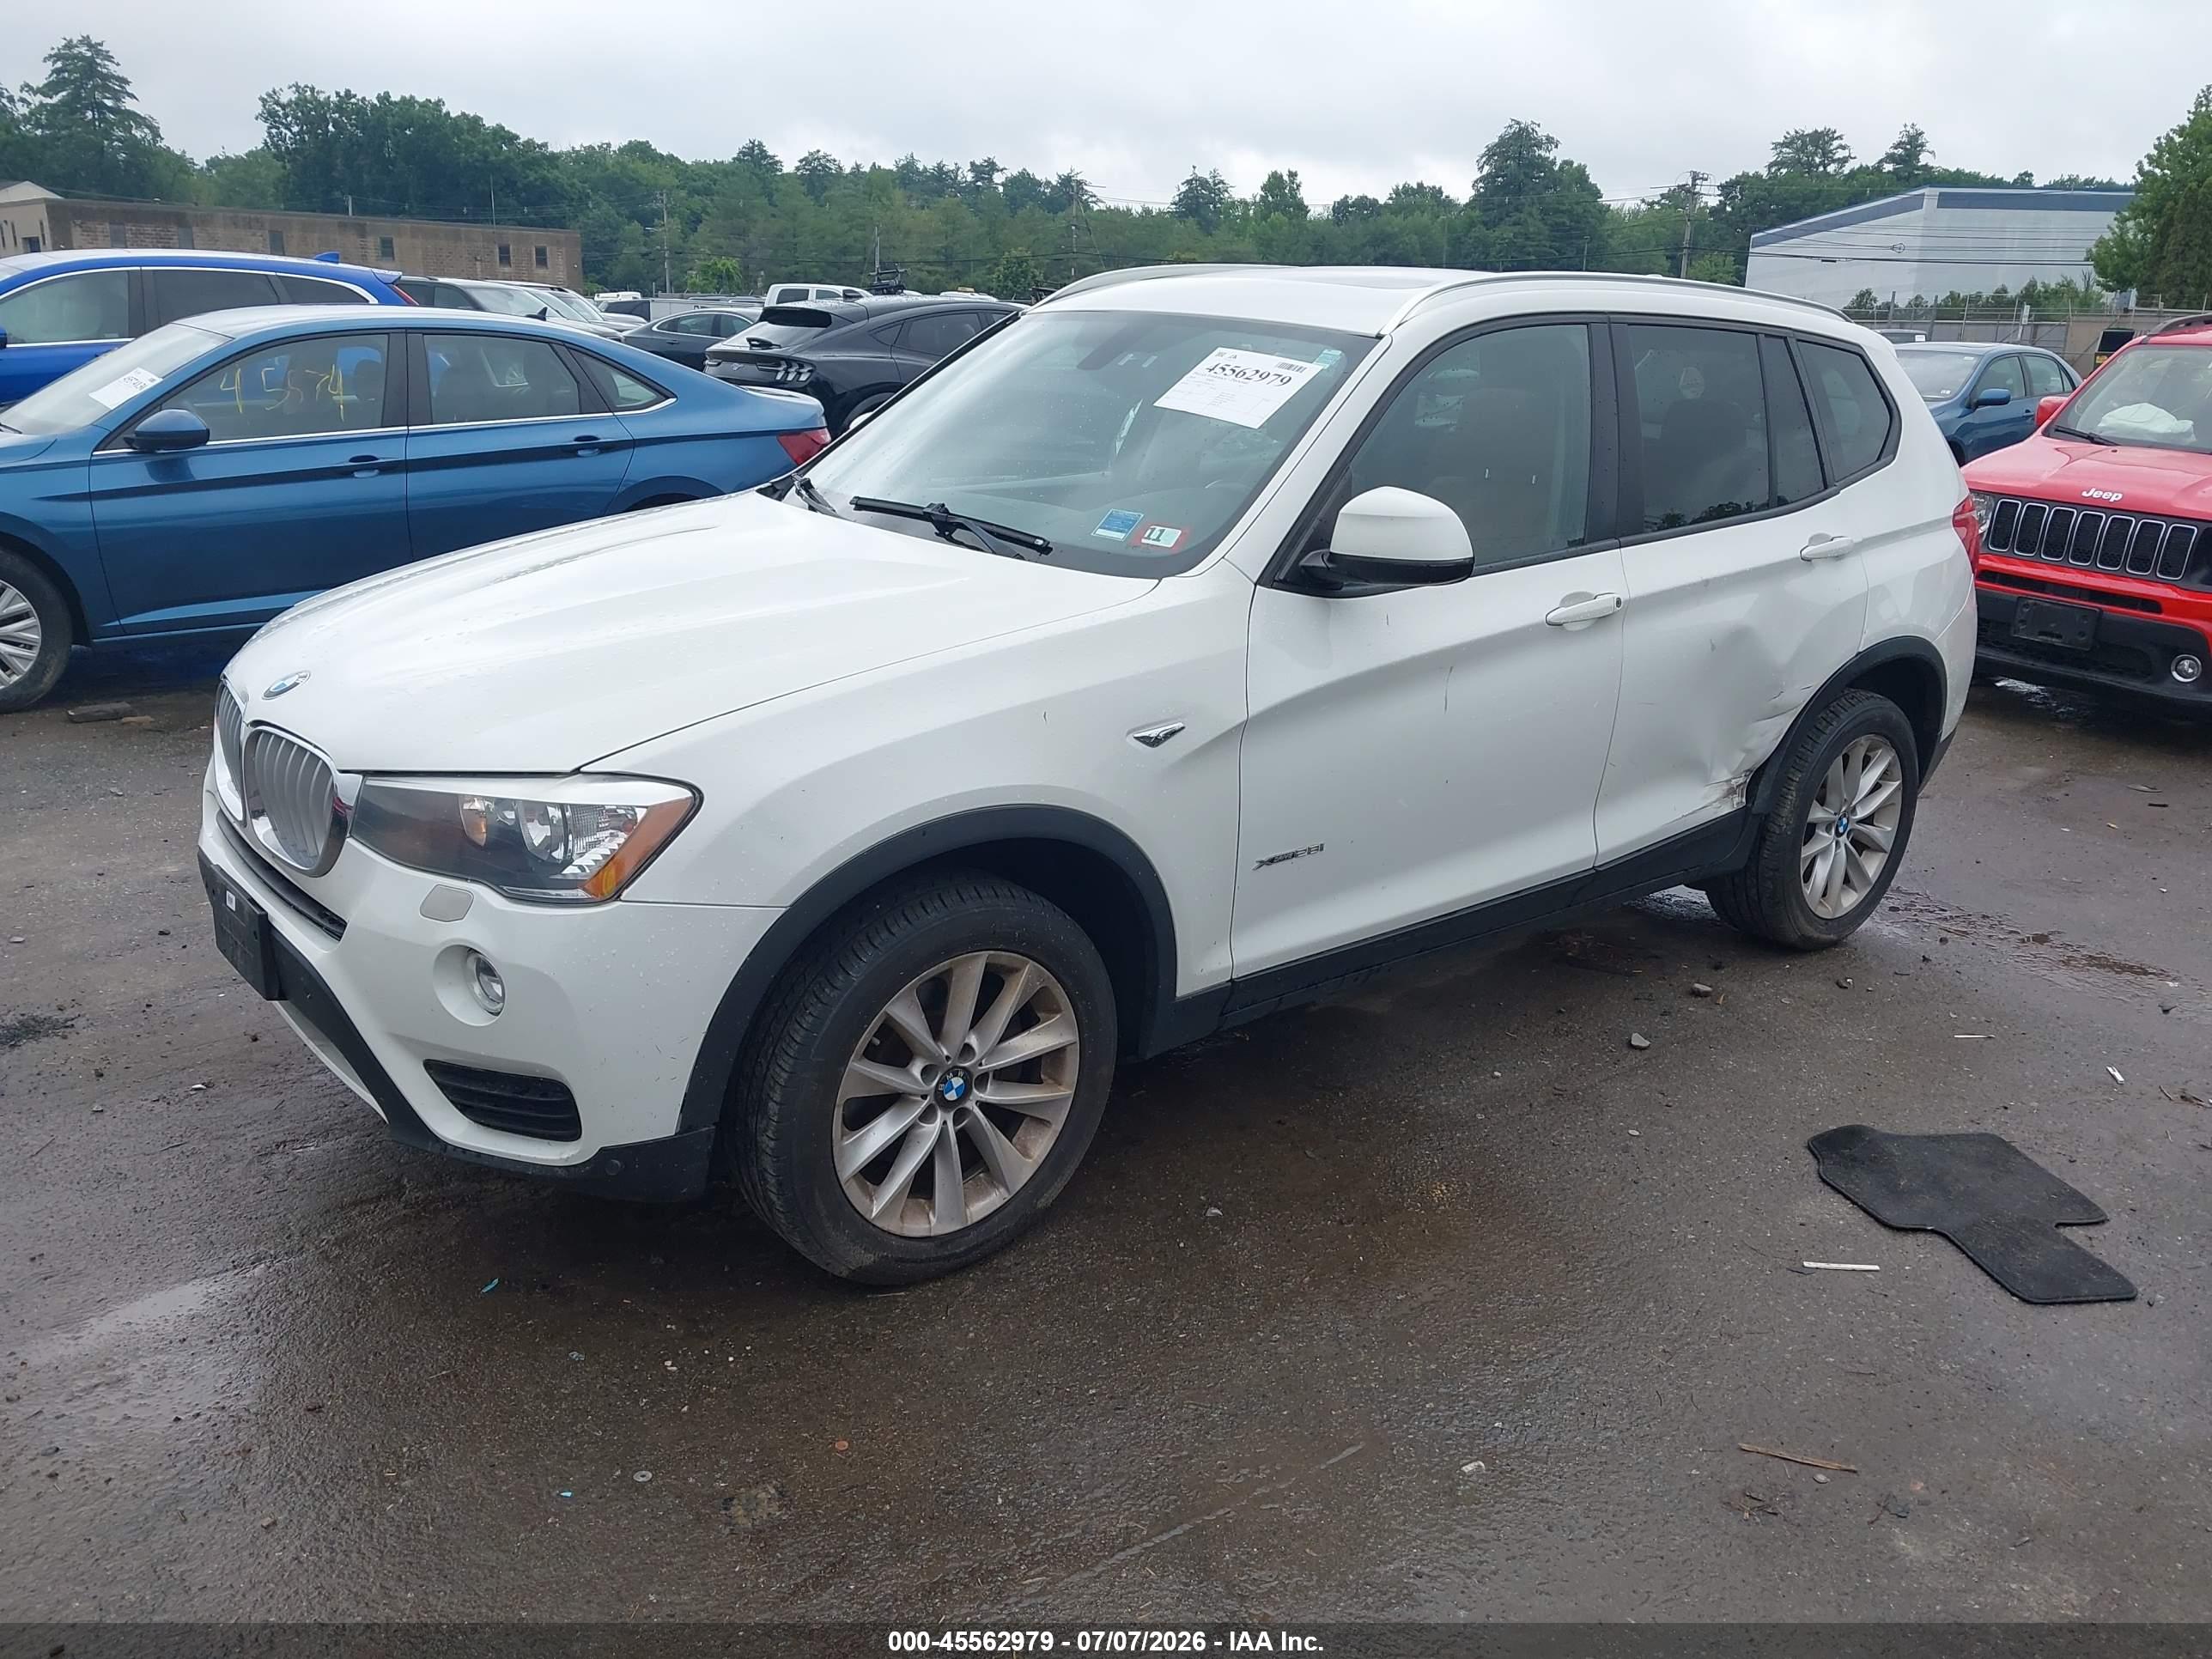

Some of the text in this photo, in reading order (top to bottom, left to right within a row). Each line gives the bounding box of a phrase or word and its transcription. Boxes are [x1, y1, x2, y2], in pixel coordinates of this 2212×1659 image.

[1205, 362, 1292, 386] 45562979
[2081, 487, 2124, 502] Jeep
[1144, 526, 1166, 543] 11
